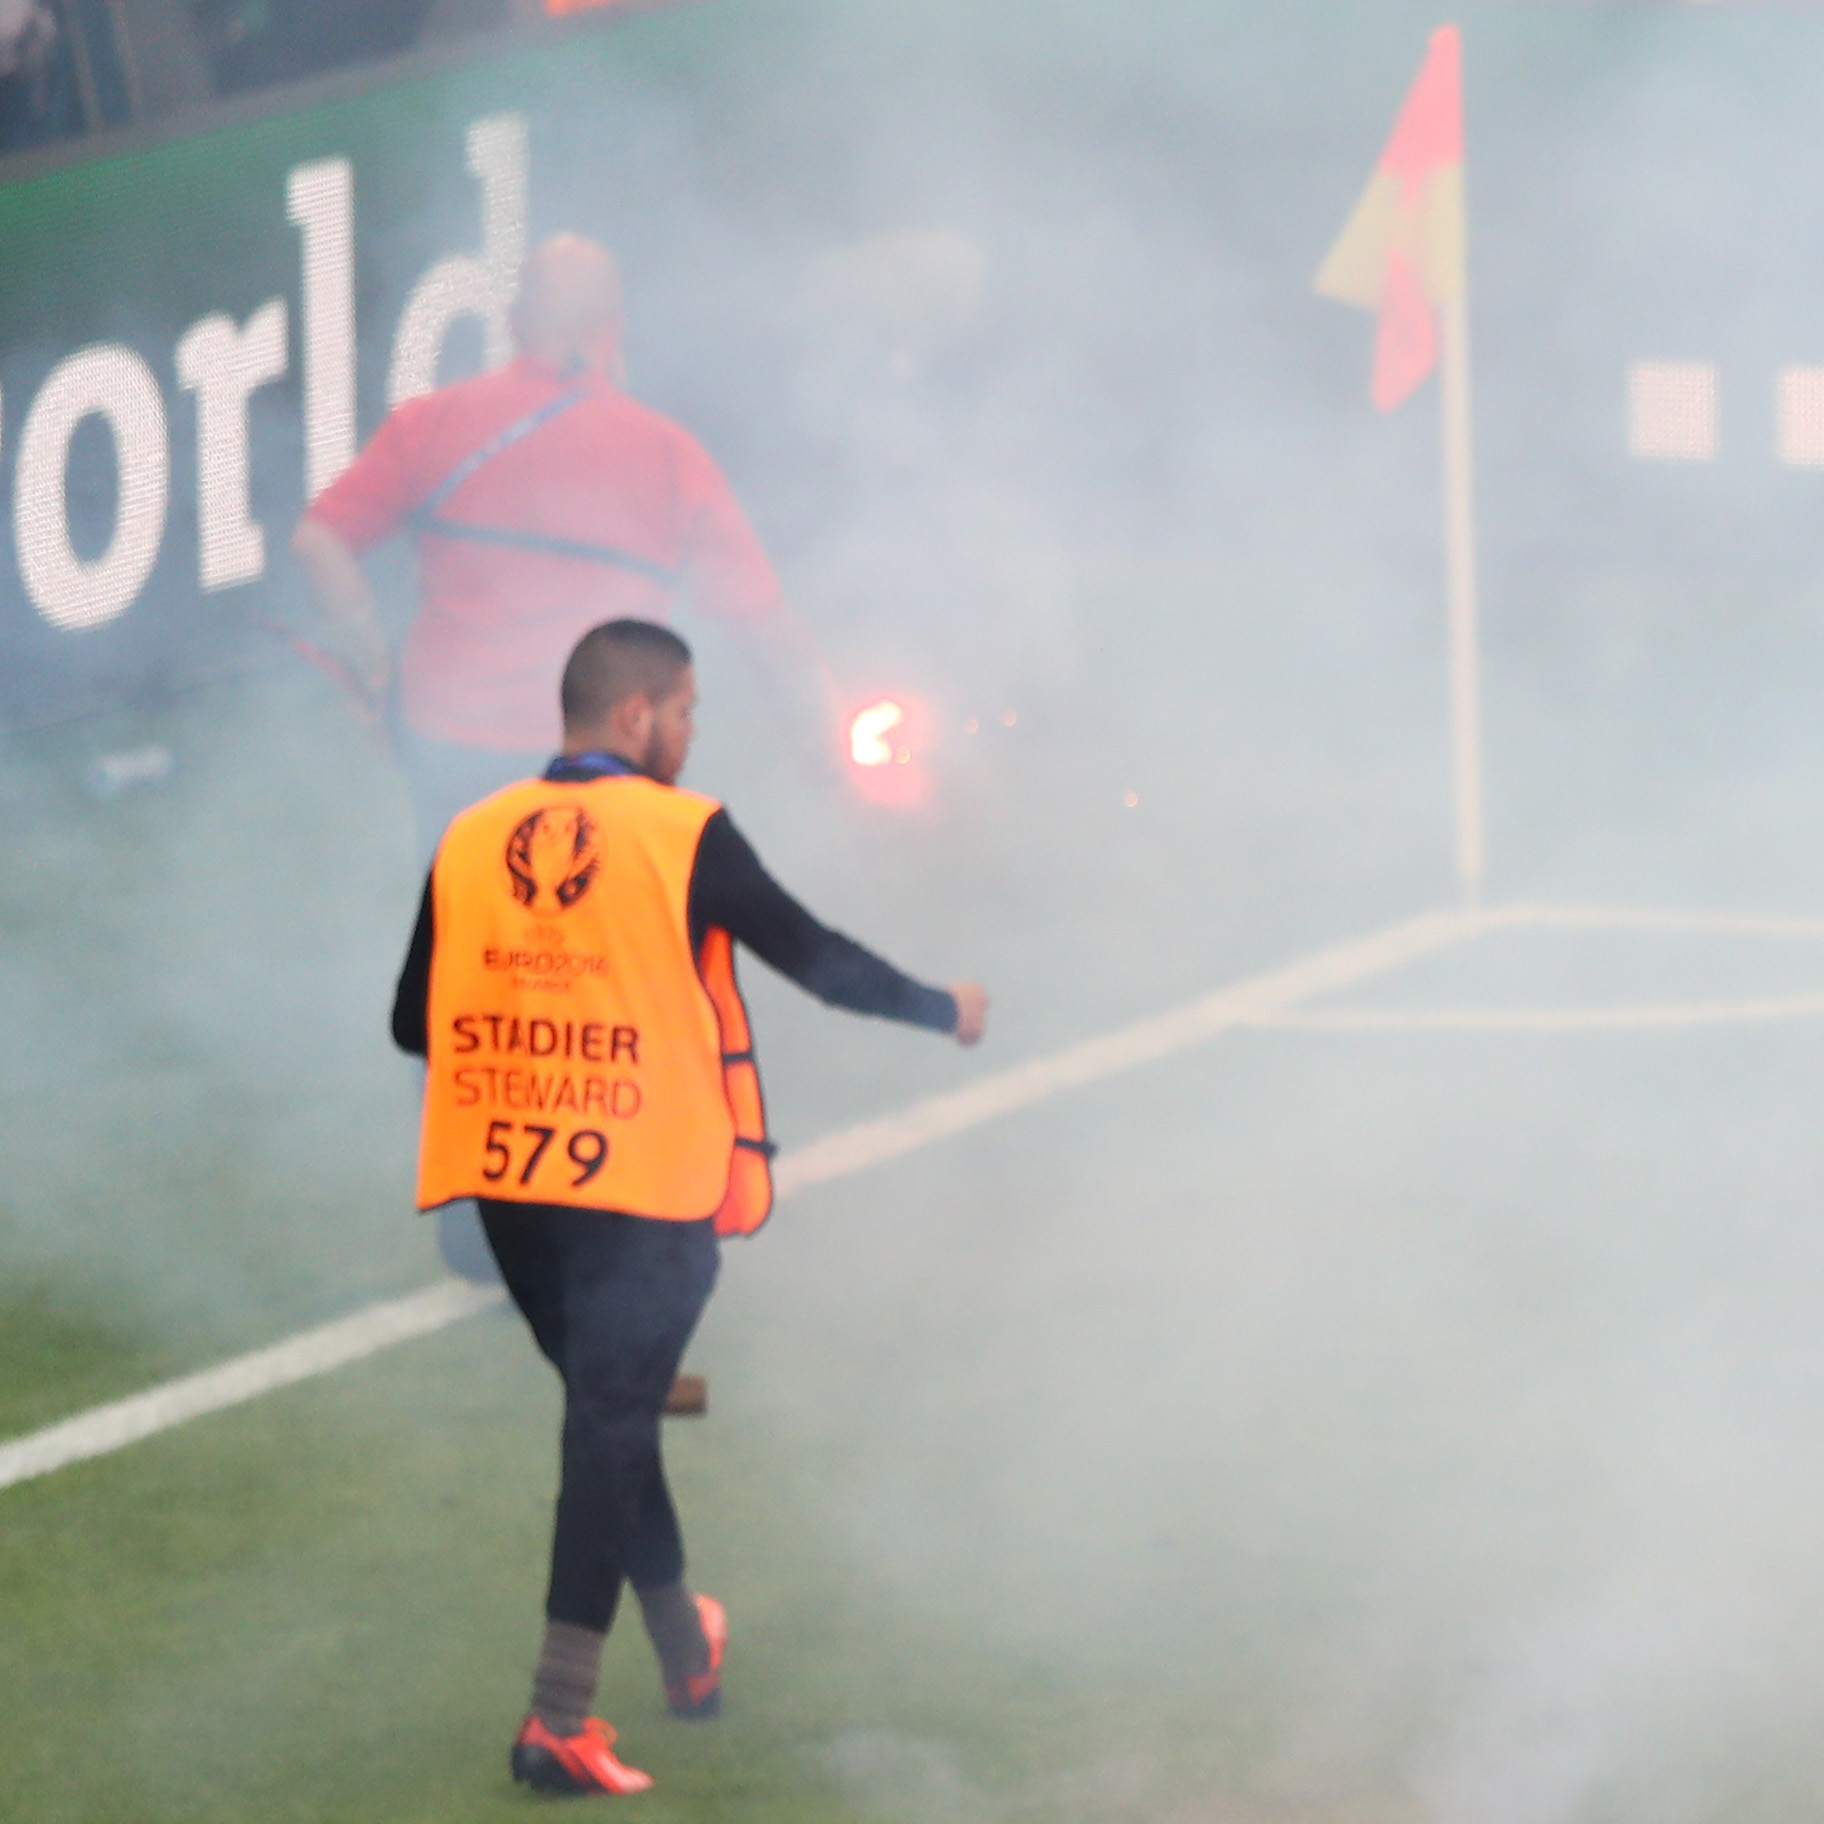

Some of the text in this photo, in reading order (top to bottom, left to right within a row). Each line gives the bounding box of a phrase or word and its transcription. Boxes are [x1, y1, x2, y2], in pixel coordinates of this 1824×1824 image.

[453, 1012, 639, 1065] STADIER
[453, 1065, 643, 1121] STEWARD
[482, 1118, 609, 1187] 579
